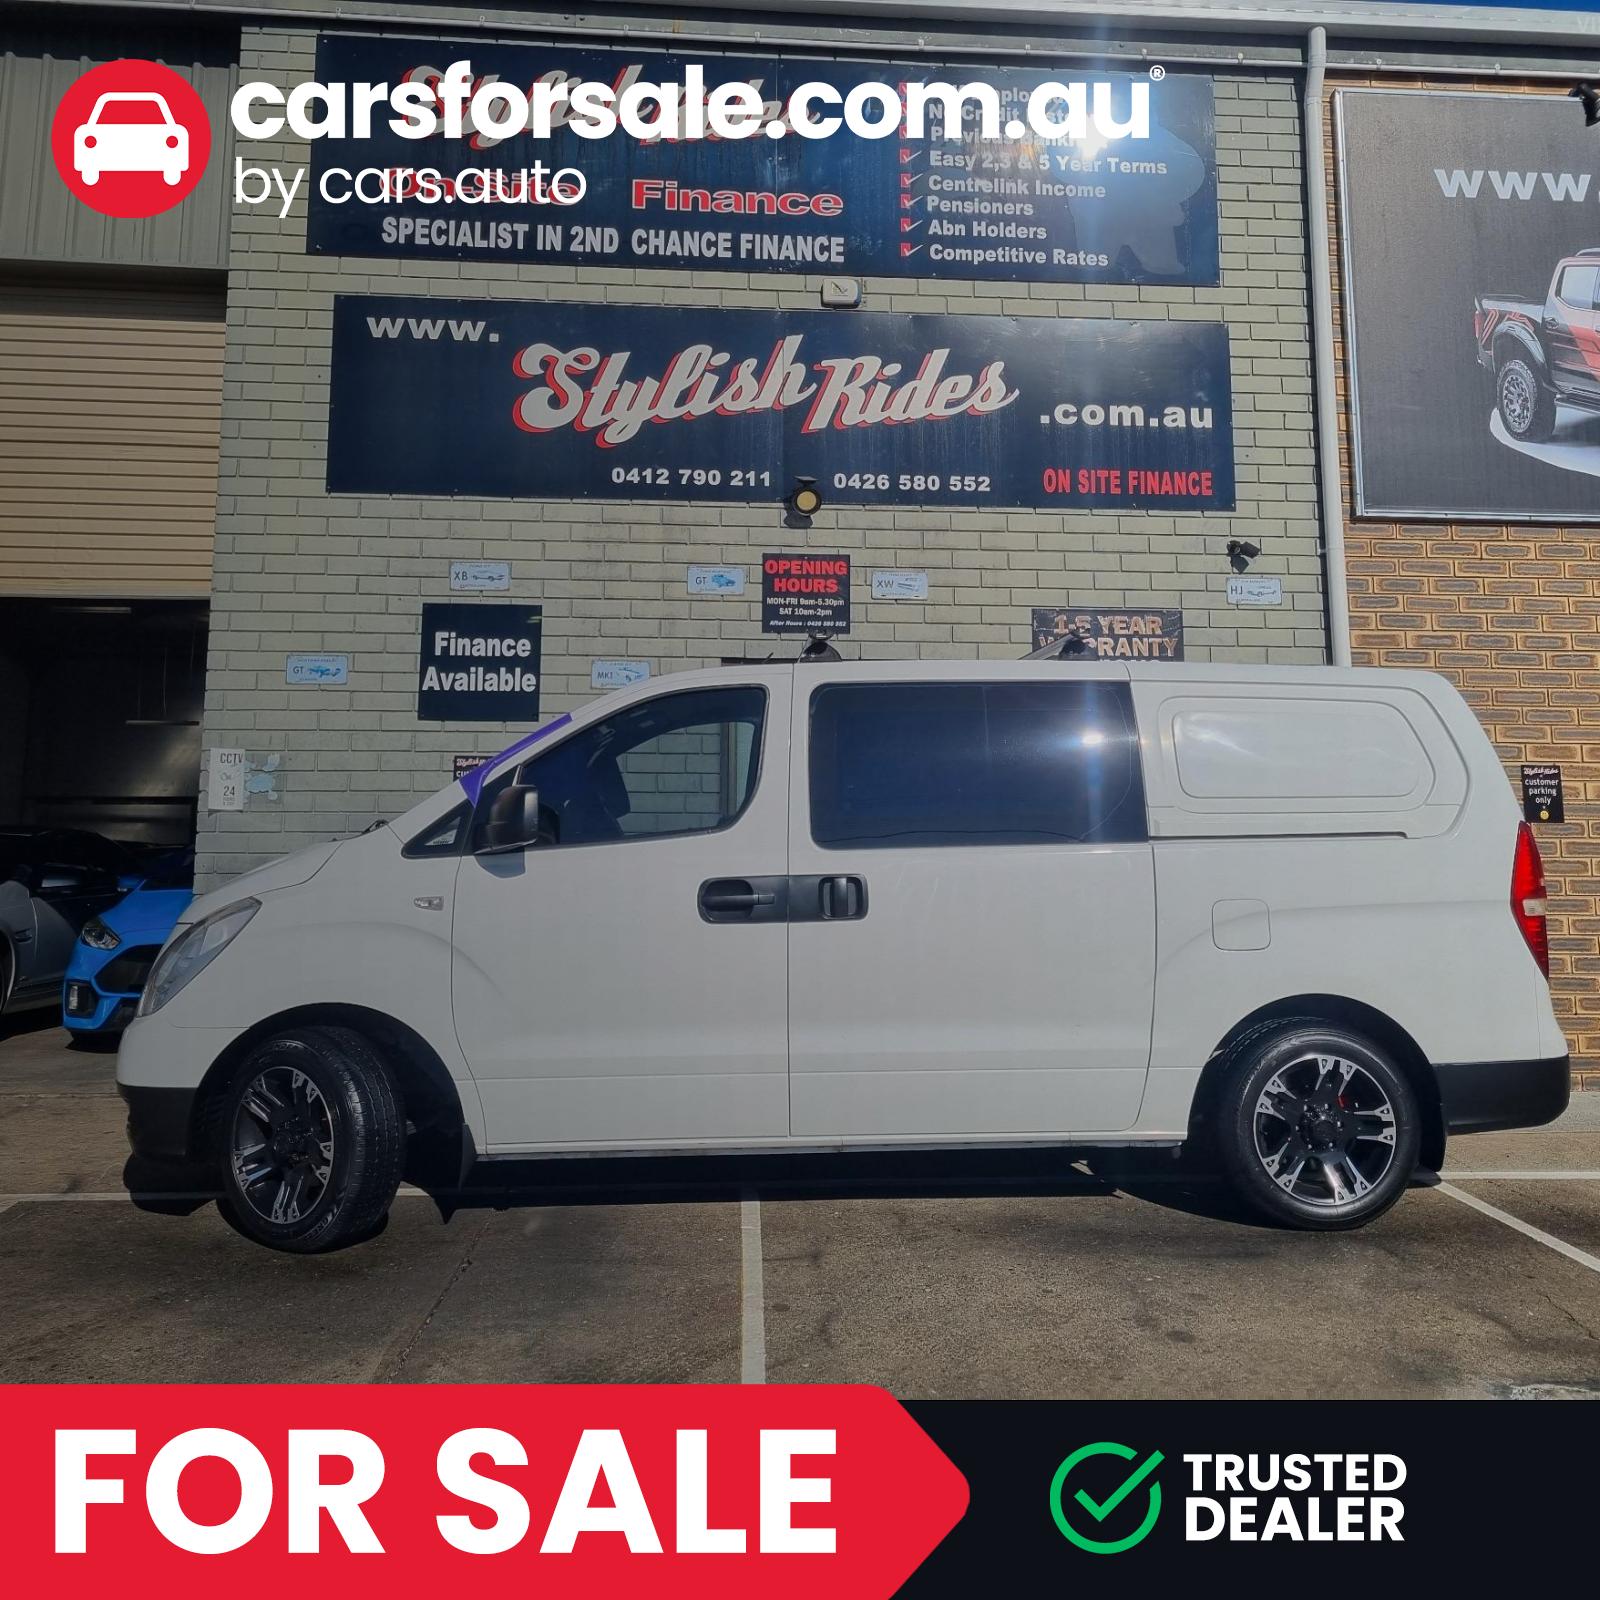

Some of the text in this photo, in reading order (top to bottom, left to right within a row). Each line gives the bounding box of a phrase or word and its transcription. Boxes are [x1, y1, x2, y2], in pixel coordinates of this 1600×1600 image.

[930, 151, 1168, 175] Easy 2,3 & 5 Year Terms
[928, 174, 1107, 198] Centrelink Income
[631, 178, 845, 217] Finance
[926, 195, 1035, 216] Pensioners
[381, 216, 846, 263] SPECIALIST IN 2ND CHANCE FINANCE
[928, 219, 1048, 240] Abn Holders
[929, 244, 1110, 267] Competitive Rates
[366, 316, 500, 343] www.
[512, 334, 1021, 449] Stylish Rides
[1039, 403, 1214, 430] .com.au
[611, 467, 771, 488] 0412 790 211
[833, 472, 992, 493] 0426 580 552
[1043, 468, 1213, 497] ON SITE FINANCE
[765, 560, 848, 576] OPENING
[774, 578, 839, 593] HOURS
[794, 608, 832, 616] 10am-2pm
[1097, 615, 1163, 634] YEAR
[434, 632, 532, 657] Finance
[422, 666, 537, 692] Available
[220, 752, 244, 766] CCTV
[223, 785, 235, 797] 24
[1524, 778, 1558, 786] customer
[1528, 787, 1557, 796] parking
[1535, 797, 1551, 805] only
